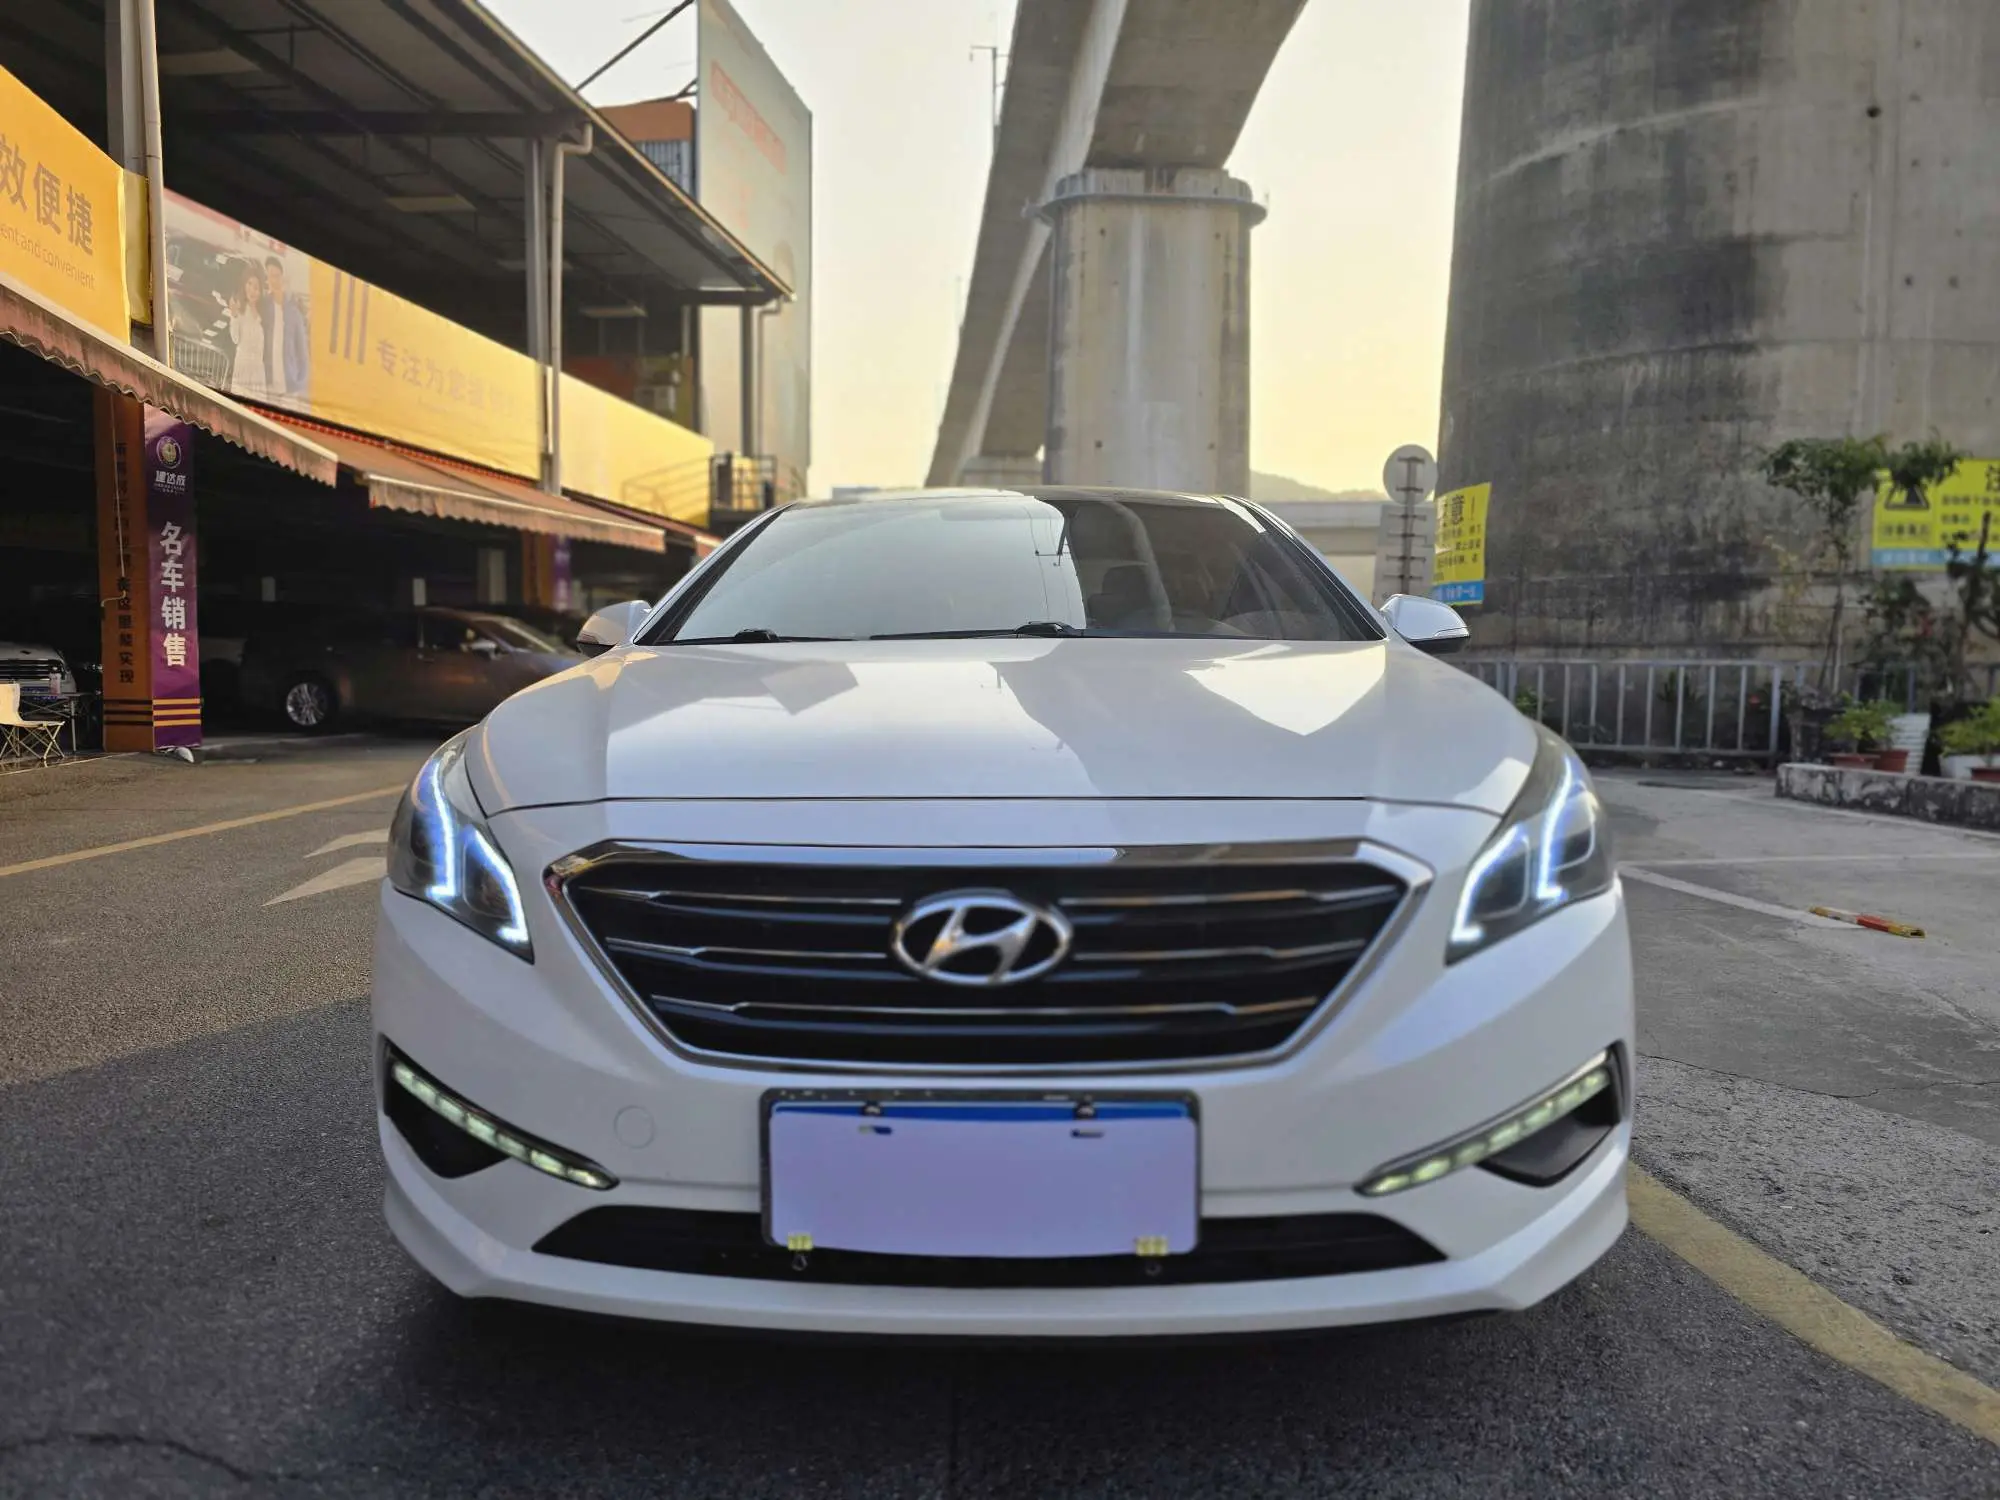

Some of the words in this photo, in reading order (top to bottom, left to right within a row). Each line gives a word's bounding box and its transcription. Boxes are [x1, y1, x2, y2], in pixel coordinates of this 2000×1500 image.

[0, 134, 93, 256] 效便捷
[42, 246, 96, 290] convenient
[160, 520, 187, 666] 名车销售
